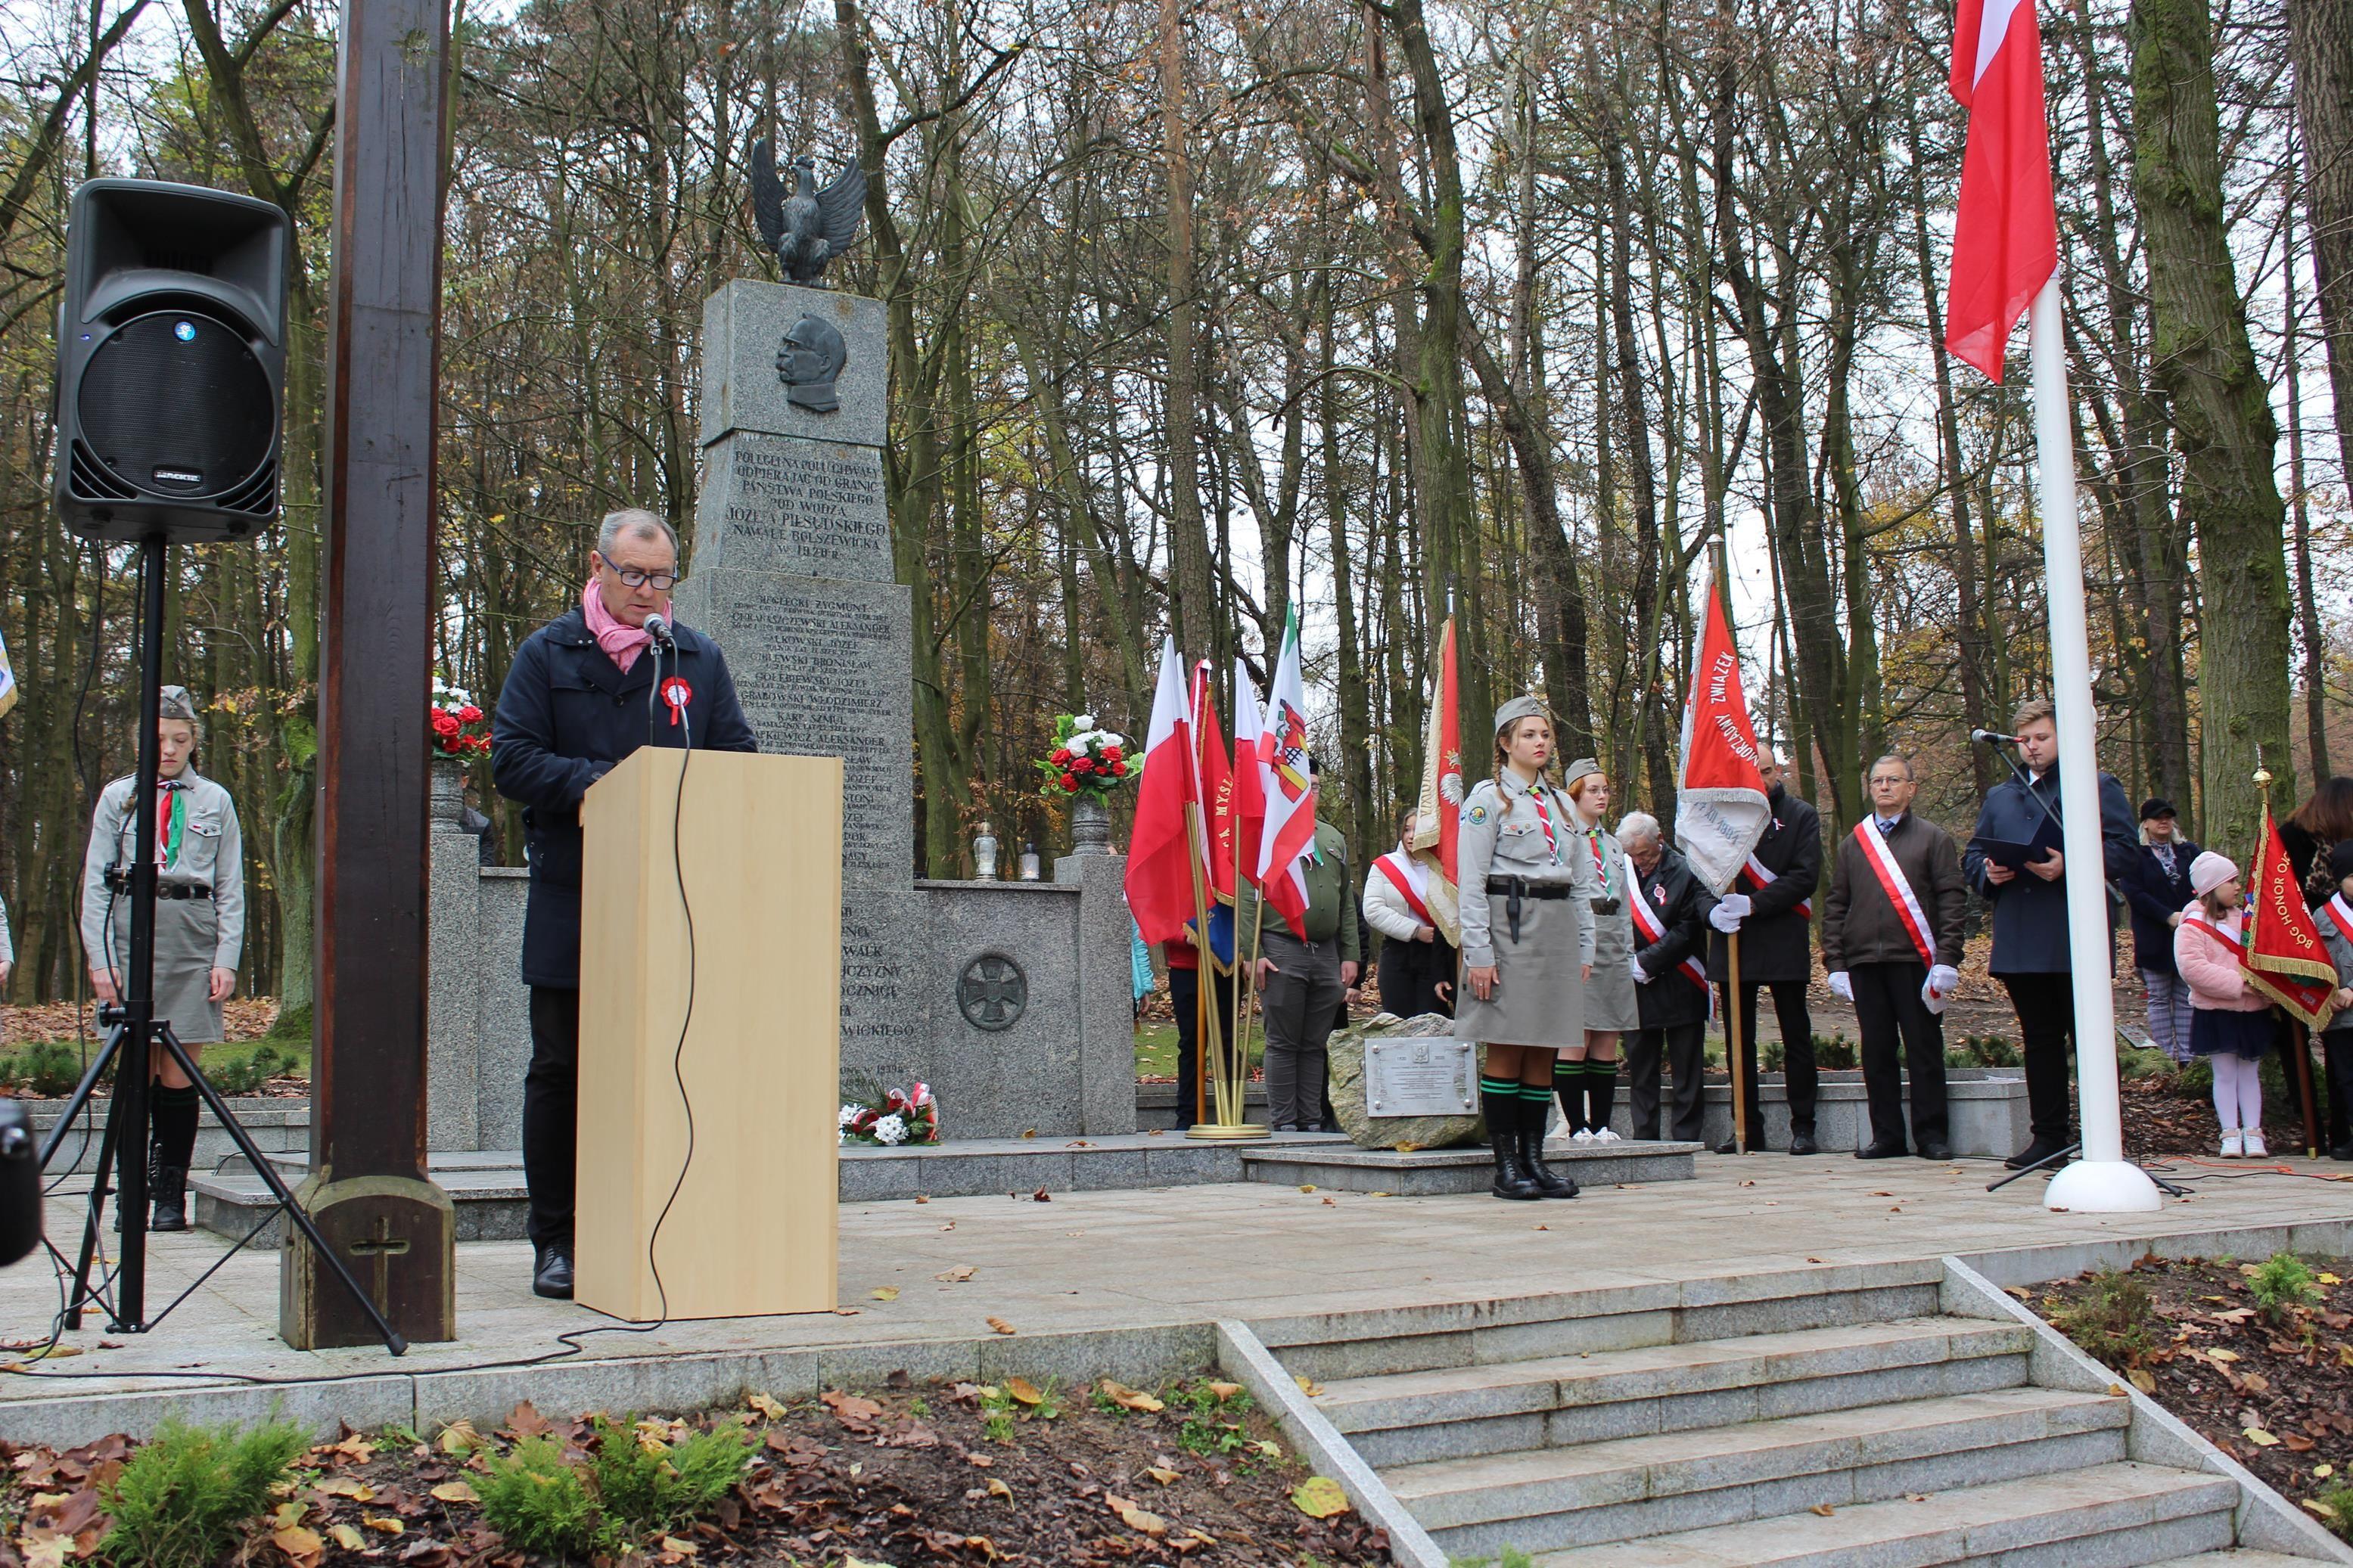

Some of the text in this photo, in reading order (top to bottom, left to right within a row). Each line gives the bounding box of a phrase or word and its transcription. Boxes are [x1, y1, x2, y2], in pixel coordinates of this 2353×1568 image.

[157, 471, 198, 481] MACKIE
[815, 474, 831, 486] OD
[835, 478, 878, 492] GRANIC
[810, 488, 873, 506] POLSKIEGO
[797, 545, 828, 558] 1920
[816, 600, 866, 613] ZYGMUNT
[830, 619, 891, 633] ALEKSANDER
[1710, 650, 1736, 704] ZWIĄZEK
[819, 735, 884, 747] ALEKSANDER
[2273, 877, 2293, 925] HONOR
[2289, 926, 2314, 950] BÓG
